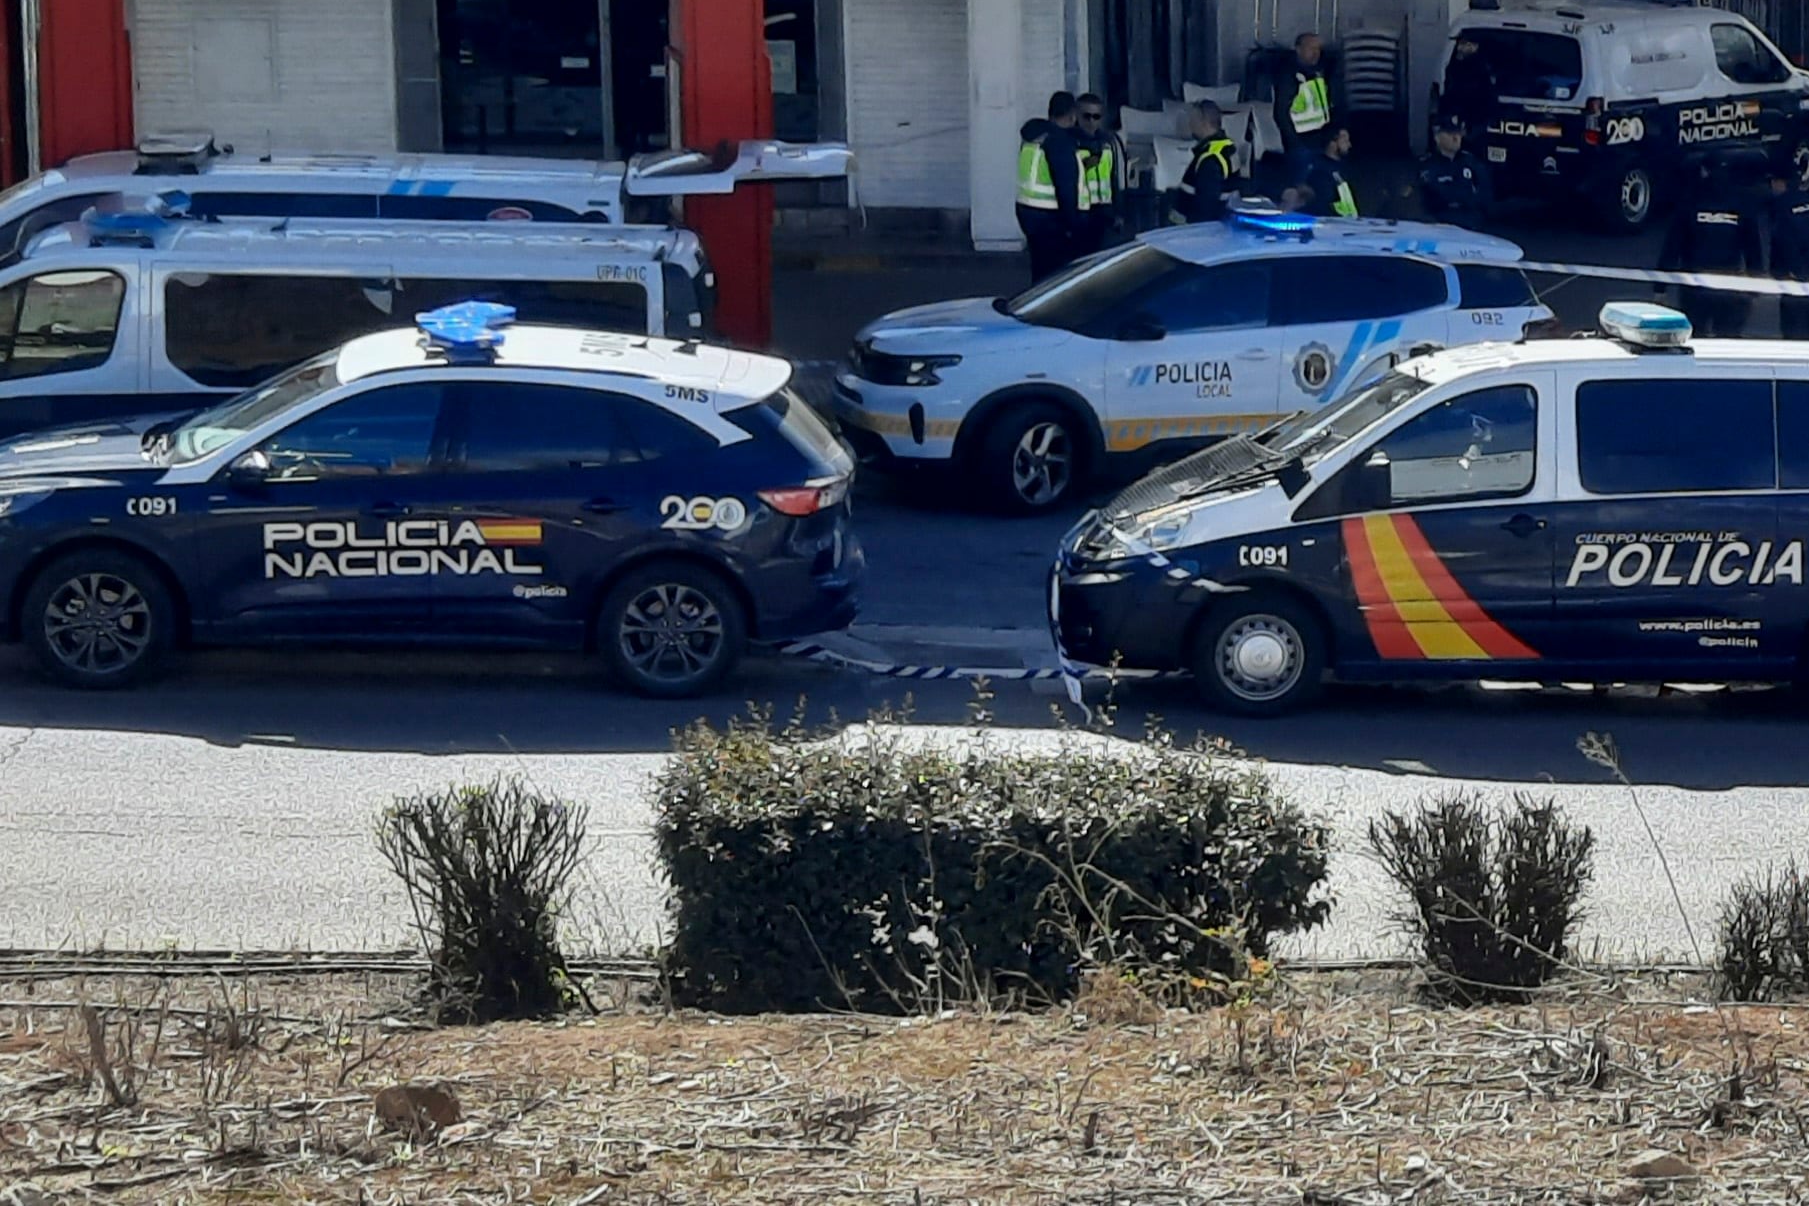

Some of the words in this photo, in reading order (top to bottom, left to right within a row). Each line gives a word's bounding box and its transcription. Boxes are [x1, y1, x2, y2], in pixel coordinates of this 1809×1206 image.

[1679, 120, 1759, 145] NACIONAL
[1471, 312, 1505, 326] 092
[1155, 361, 1233, 384] POLICIA
[1196, 384, 1233, 398] LOCAL
[1574, 533, 1637, 545] CUERPO
[1640, 531, 1714, 544] NACIONAL
[264, 548, 543, 579] NACIONAL
[512, 583, 568, 600] @policia
[1638, 618, 1762, 632] www.policia.es
